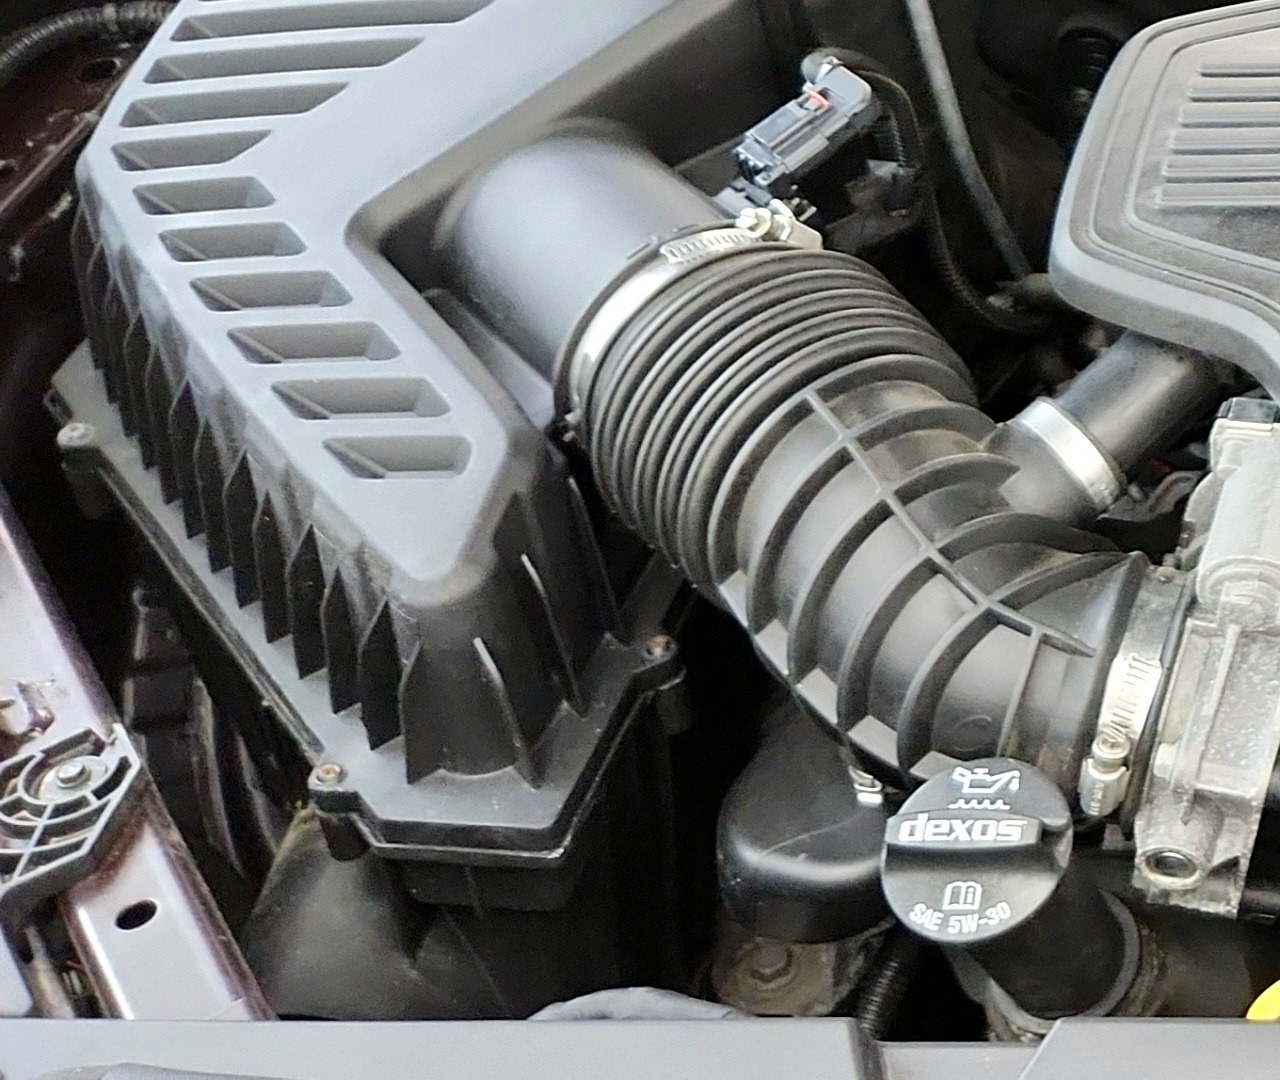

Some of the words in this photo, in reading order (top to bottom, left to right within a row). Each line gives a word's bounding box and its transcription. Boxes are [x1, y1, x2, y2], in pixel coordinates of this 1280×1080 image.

[898, 813, 1028, 842] dexos
[909, 903, 944, 931] SAE
[947, 901, 1011, 934] 5W-30
